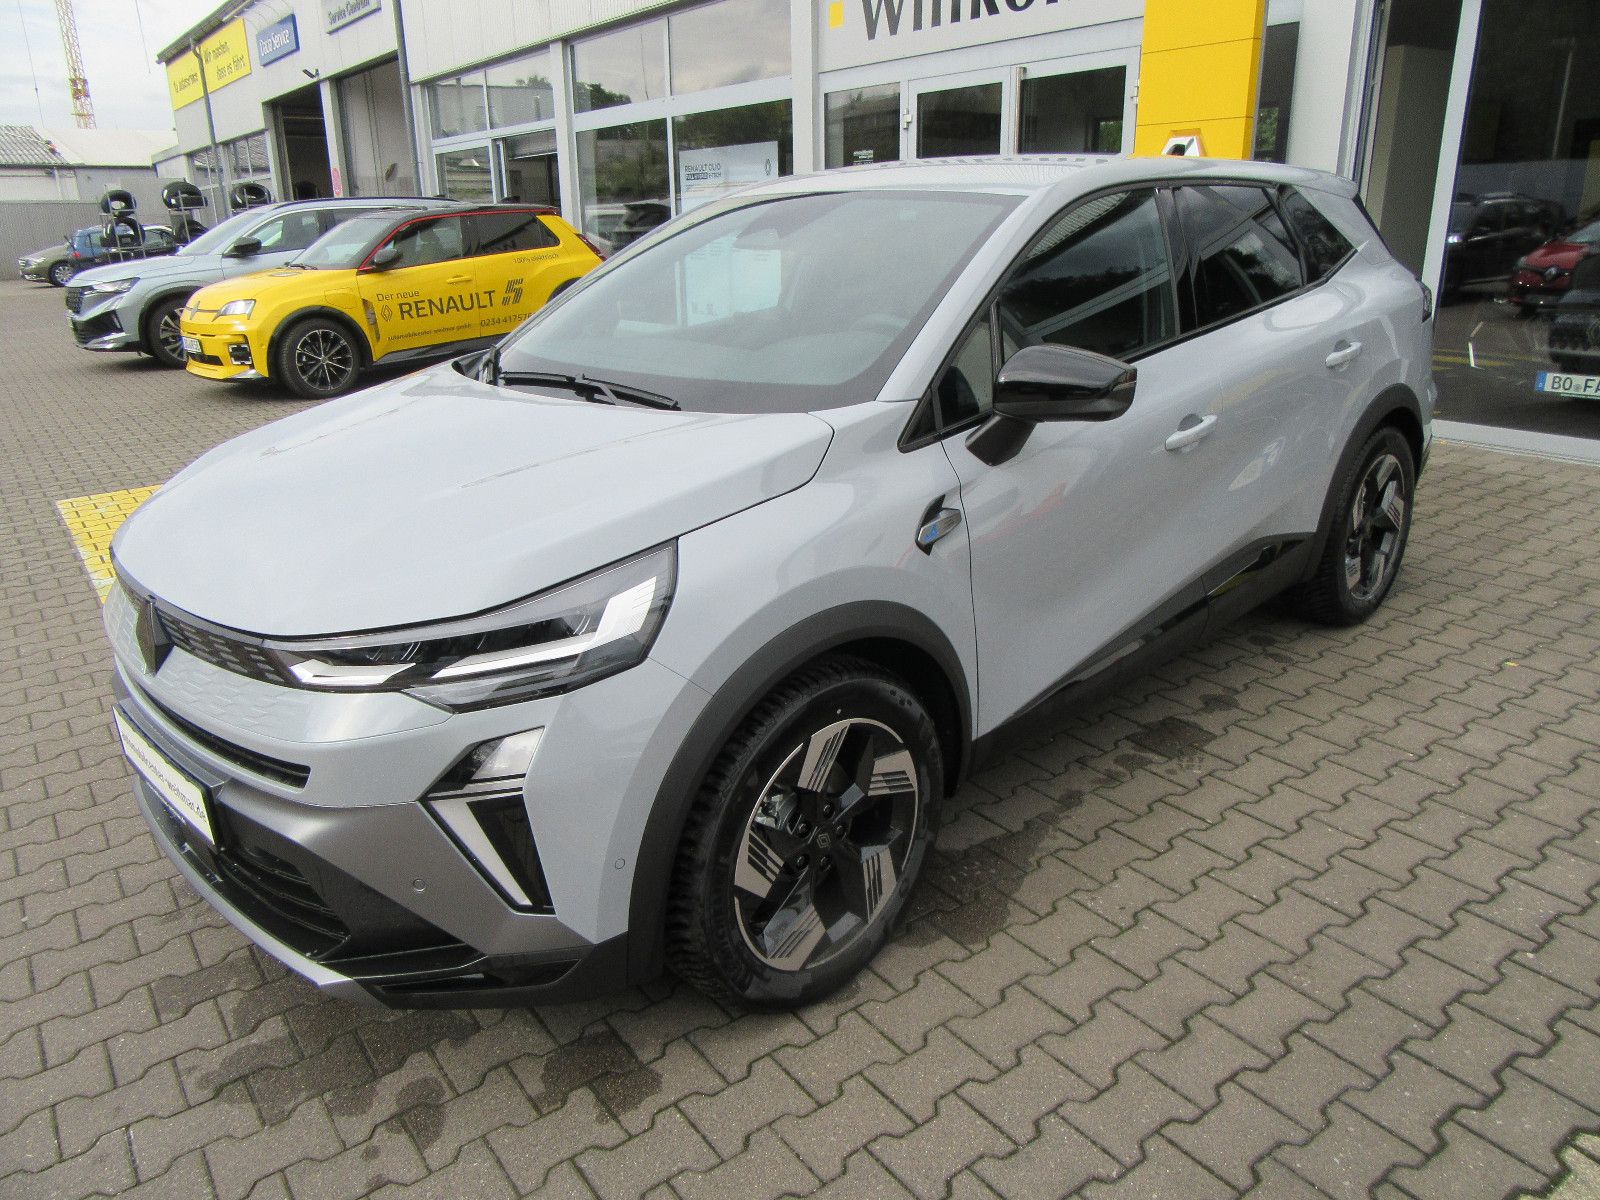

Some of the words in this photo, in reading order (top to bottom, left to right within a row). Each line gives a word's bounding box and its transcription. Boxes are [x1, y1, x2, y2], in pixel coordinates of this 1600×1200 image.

[259, 39, 273, 56] Dacia
[272, 29, 290, 50] Service
[203, 48, 212, 64] Wir
[684, 163, 708, 173] RENAULT
[376, 292, 394, 302] Der
[396, 289, 420, 299] neue
[398, 290, 496, 321] RENAULT
[480, 318, 501, 328] 0234
[1551, 375, 1573, 391] BO
